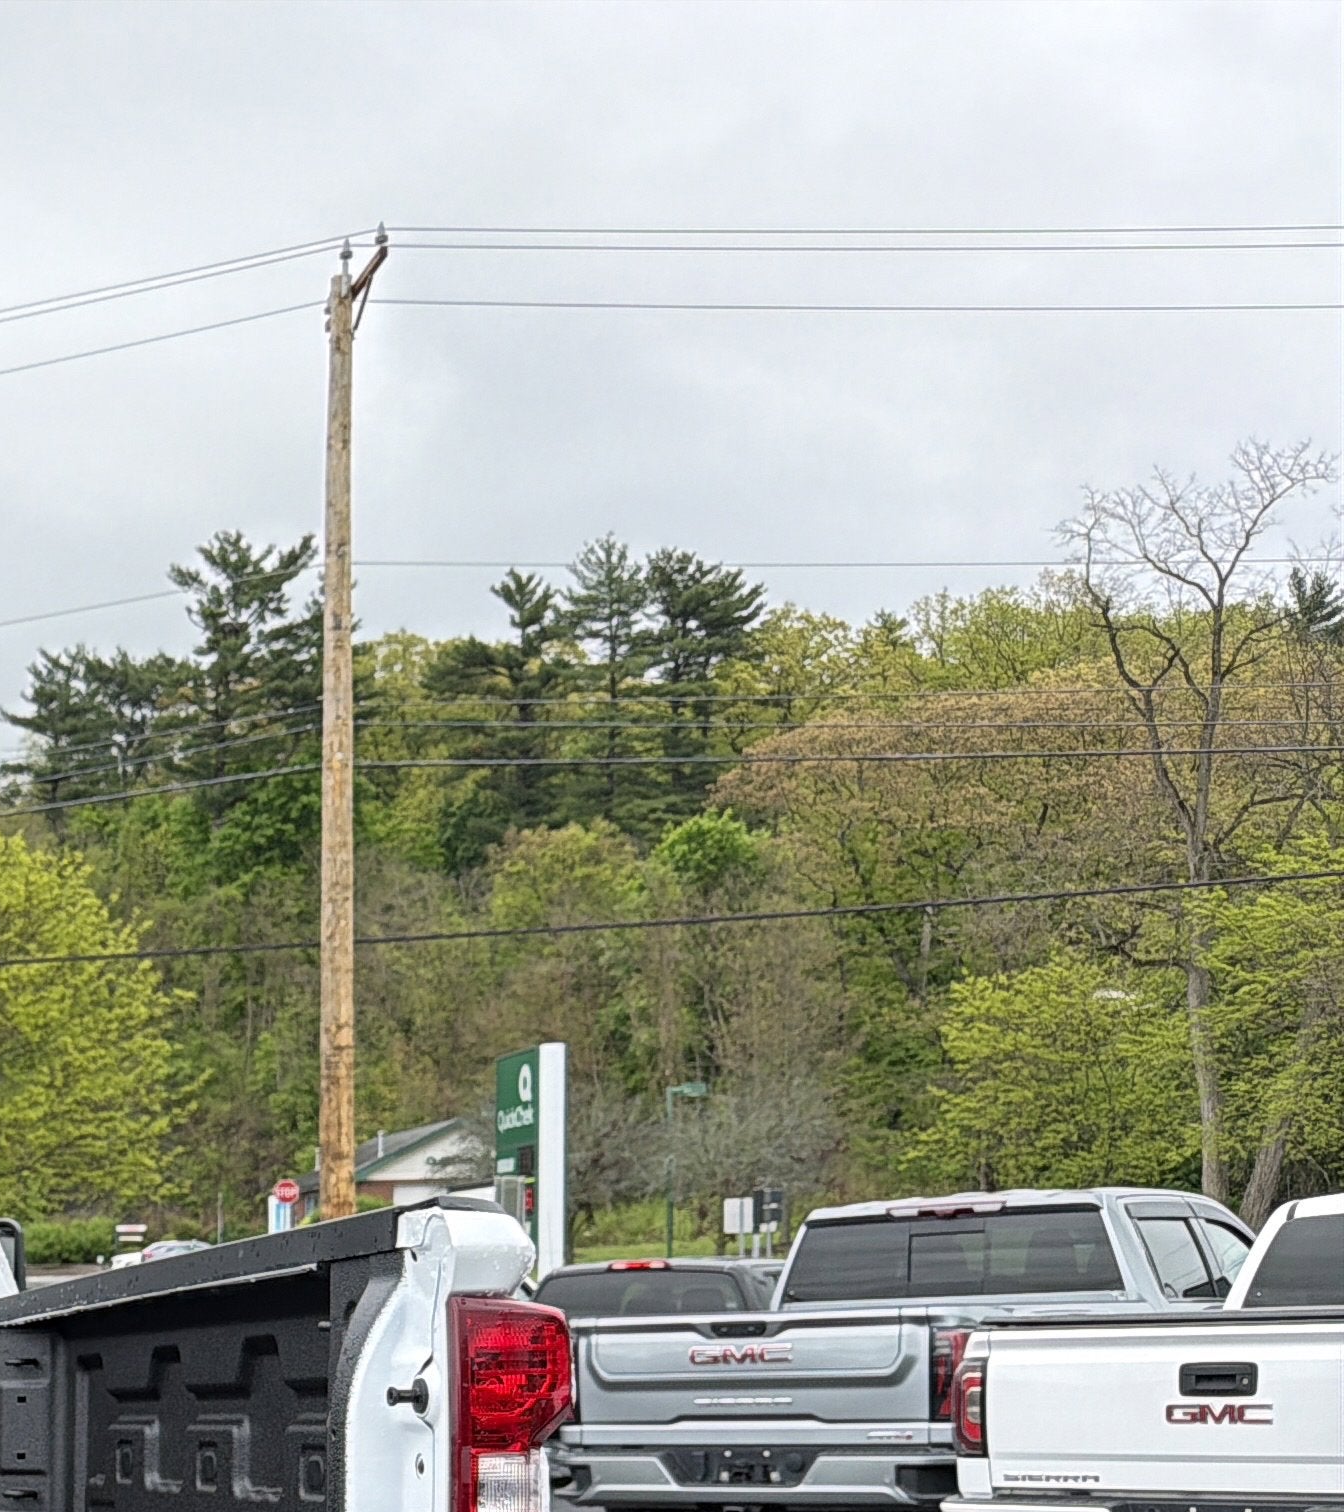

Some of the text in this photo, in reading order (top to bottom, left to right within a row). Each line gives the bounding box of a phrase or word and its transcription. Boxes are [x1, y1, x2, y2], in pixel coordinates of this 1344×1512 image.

[688, 1342, 793, 1365] GMC
[1165, 1403, 1274, 1426] GMC
[1003, 1473, 1100, 1483] SIERRA
